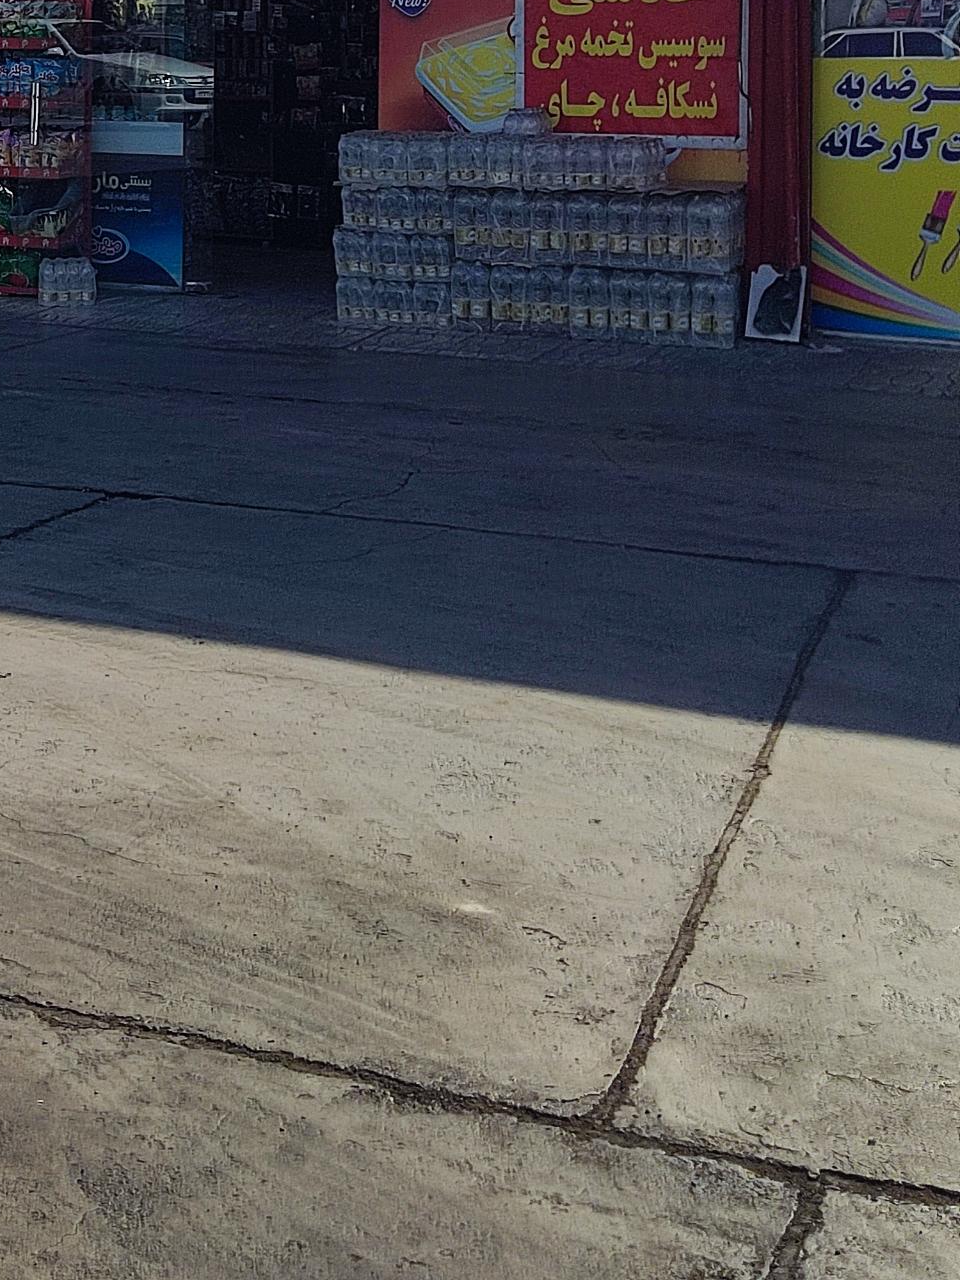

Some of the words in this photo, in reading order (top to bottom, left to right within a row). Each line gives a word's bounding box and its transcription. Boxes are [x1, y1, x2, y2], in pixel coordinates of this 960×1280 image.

[531, 15, 577, 70] مرغ
[638, 32, 727, 70] سوسیس
[835, 72, 867, 110] به
[869, 66, 960, 113] رضه
[818, 122, 940, 171] کارخانه
